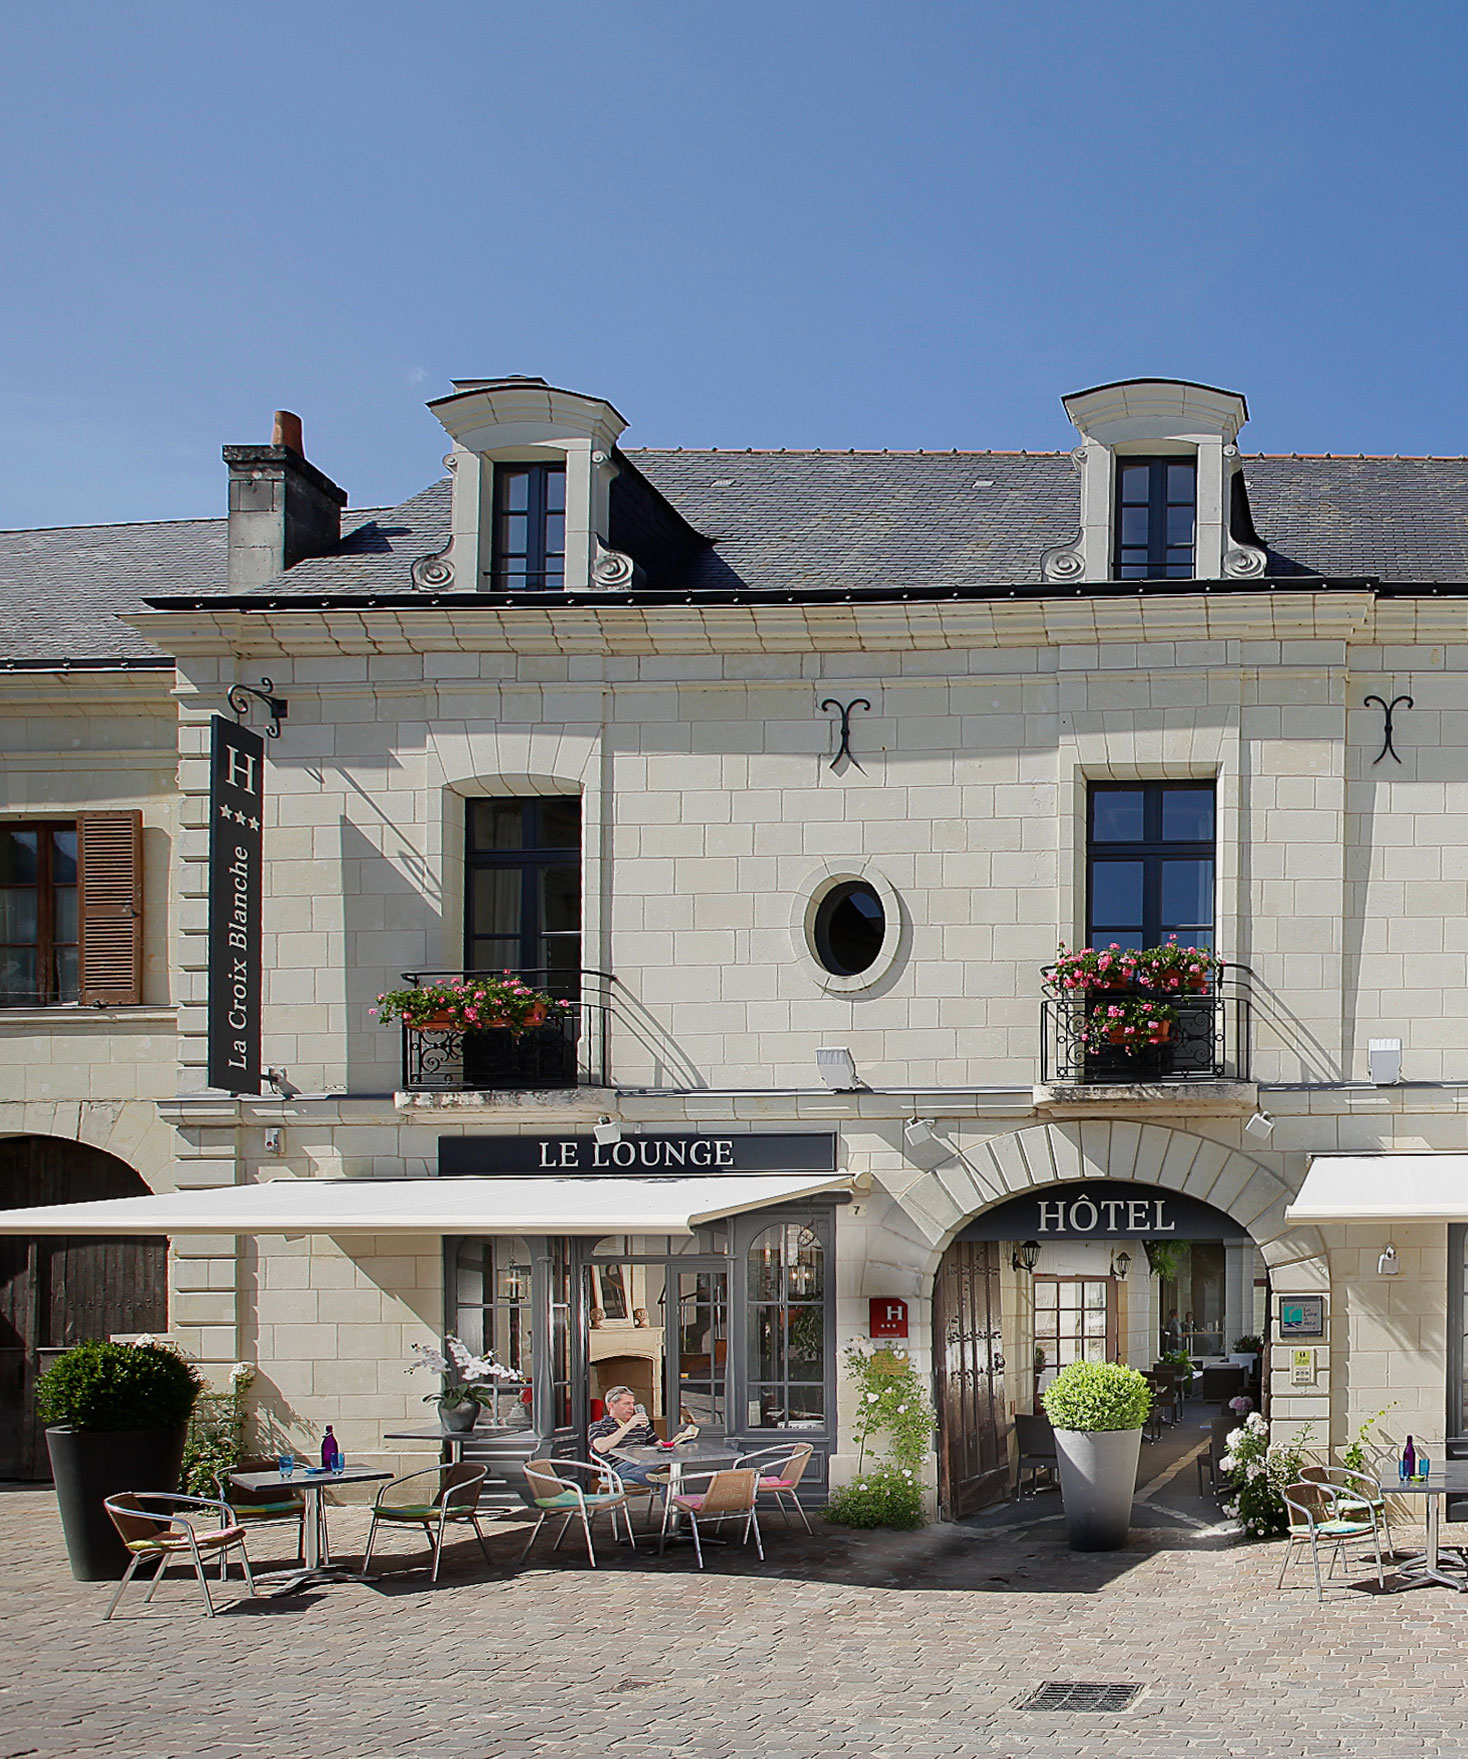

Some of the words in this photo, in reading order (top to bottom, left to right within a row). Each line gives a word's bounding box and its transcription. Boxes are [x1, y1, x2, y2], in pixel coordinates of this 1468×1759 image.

[225, 744, 256, 796] H
[228, 846, 248, 952] Blanche
[228, 957, 248, 1030] Croix
[229, 1040, 248, 1070] La
[538, 1142, 579, 1167] LE
[592, 1140, 734, 1167] LOUNGE
[853, 1205, 861, 1216] 7
[1037, 1194, 1176, 1232] HÔTEL
[886, 1305, 904, 1321] H
